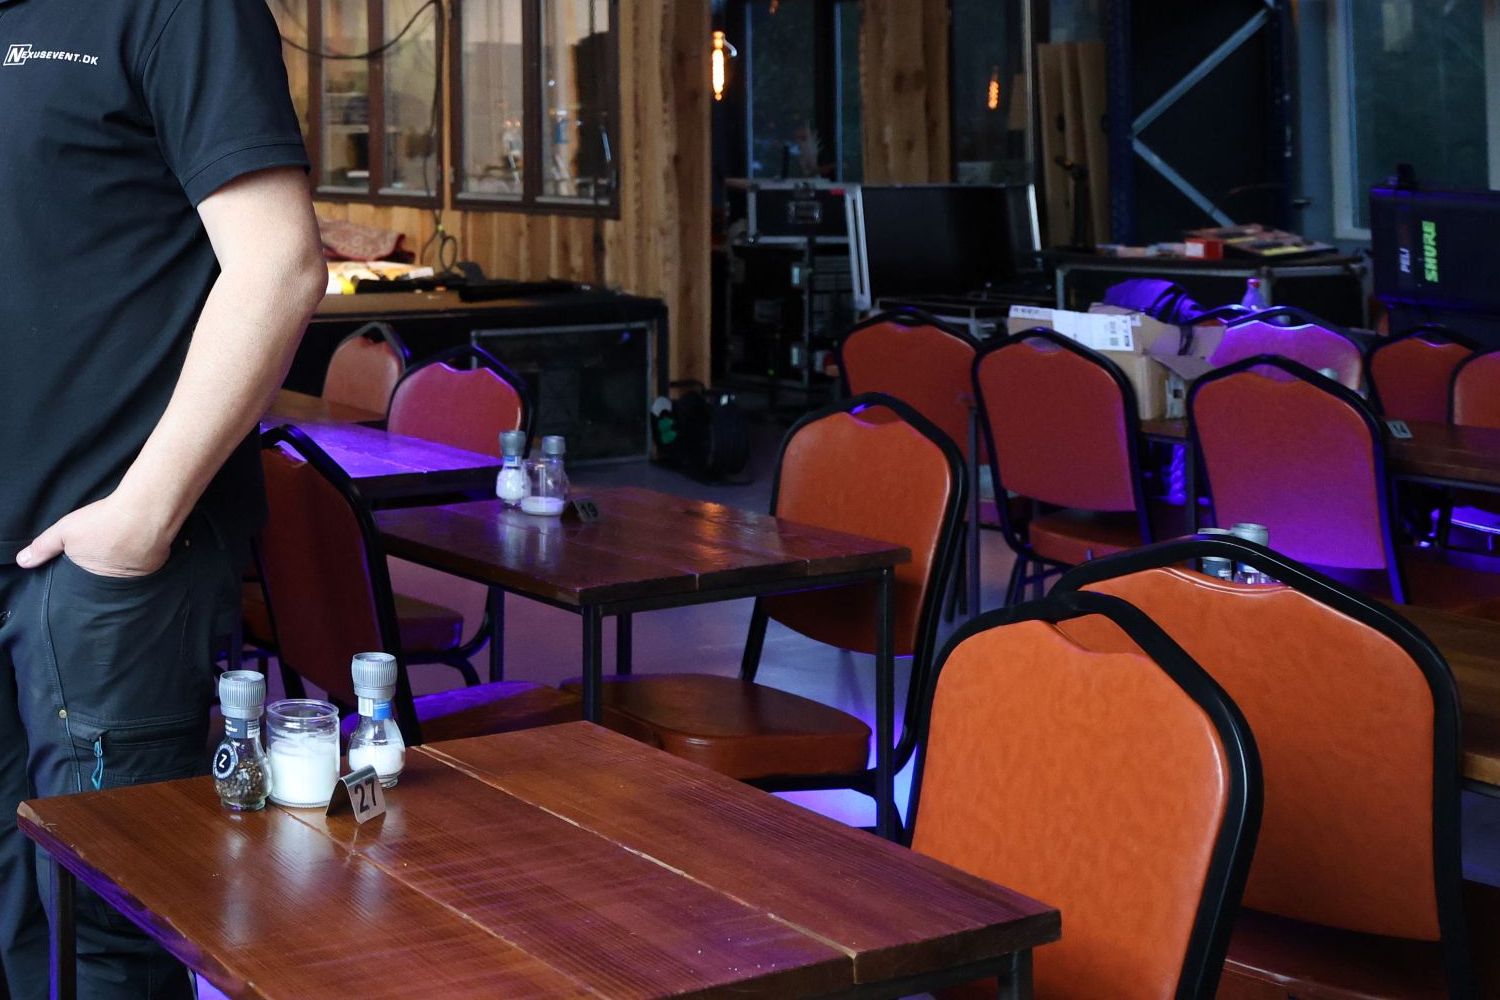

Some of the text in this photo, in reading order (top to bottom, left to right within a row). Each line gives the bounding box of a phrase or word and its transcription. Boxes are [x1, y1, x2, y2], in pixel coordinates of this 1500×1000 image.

[1422, 220, 1439, 282] SHURE
[581, 502, 598, 517] 19
[353, 778, 378, 813] 27
